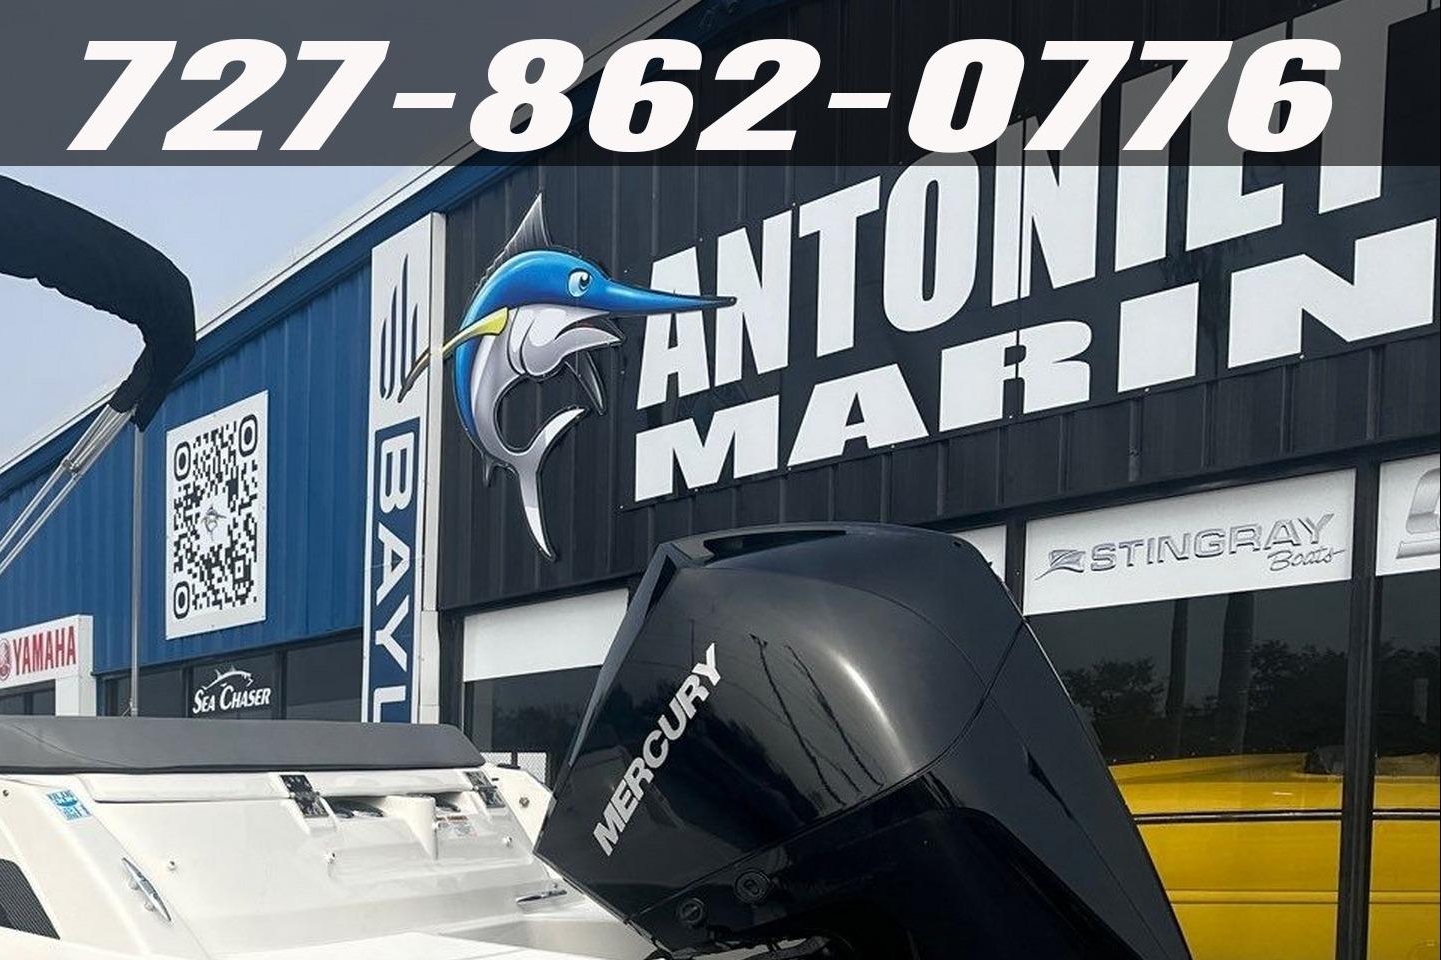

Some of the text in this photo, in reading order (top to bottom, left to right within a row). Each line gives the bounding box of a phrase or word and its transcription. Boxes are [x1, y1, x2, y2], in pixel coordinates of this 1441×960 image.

[1090, 512, 1335, 572] STINGRAY
[1266, 547, 1347, 573] Boats
[12, 625, 77, 677] YAMAHA
[593, 642, 722, 857] MERCURY
